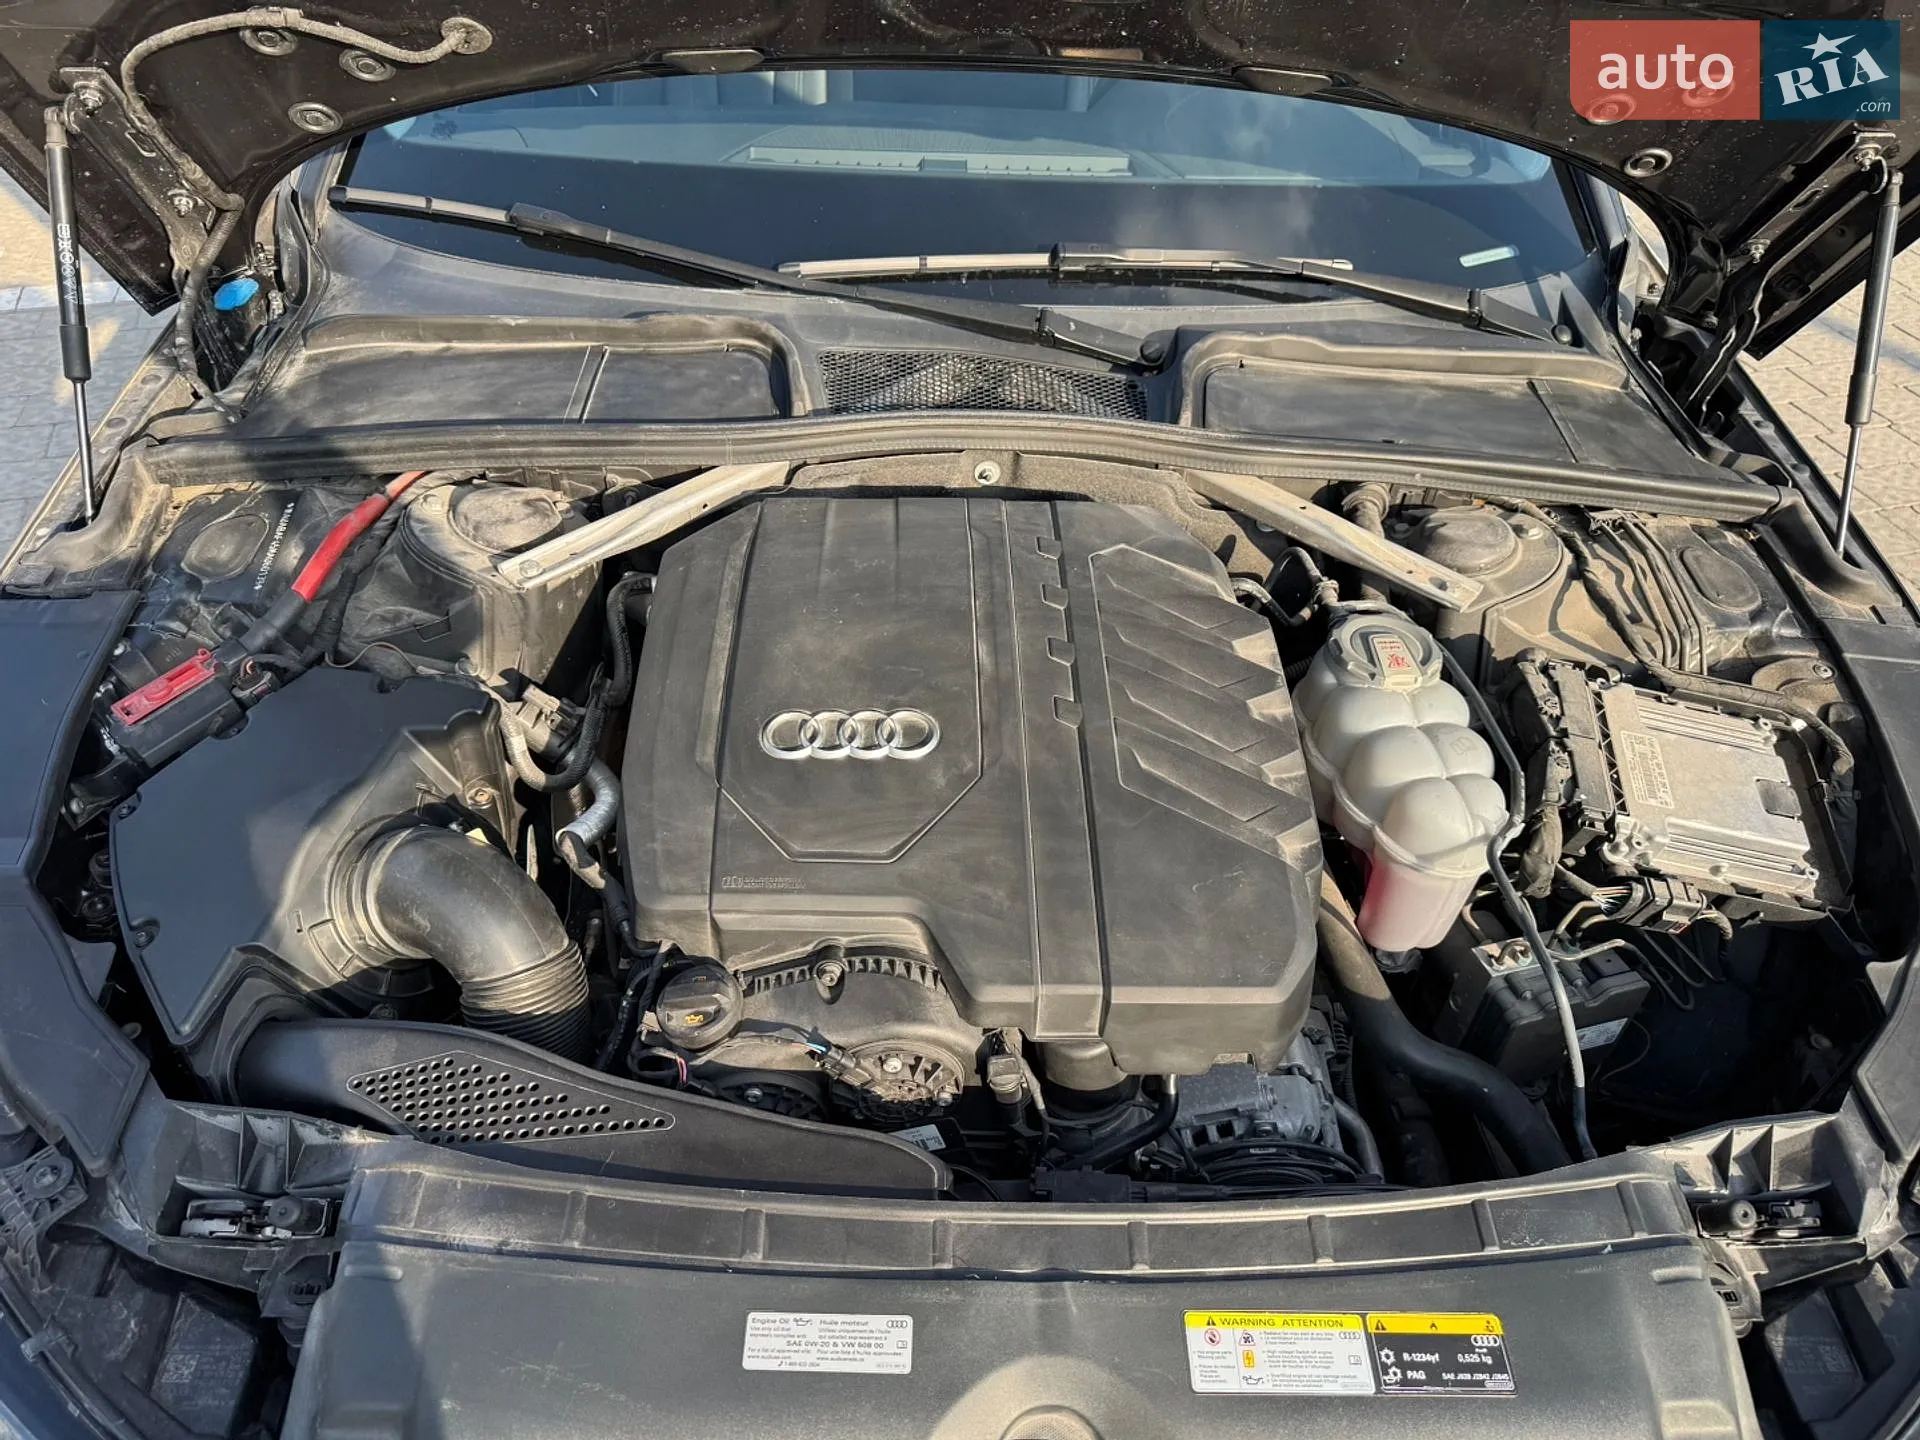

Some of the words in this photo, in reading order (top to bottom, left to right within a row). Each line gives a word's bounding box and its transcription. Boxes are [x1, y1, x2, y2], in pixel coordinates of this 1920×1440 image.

[751, 1317, 777, 1325] Engine
[1219, 1317, 1275, 1327] WARNING
[1283, 1318, 1344, 1328] ATTENTION
[1403, 1352, 1440, 1364] R-1234yf
[1457, 1354, 1479, 1363] 0,525
[1482, 1354, 1493, 1364] kg
[1407, 1370, 1427, 1380] PAG
[1441, 1372, 1455, 1380] SAE
